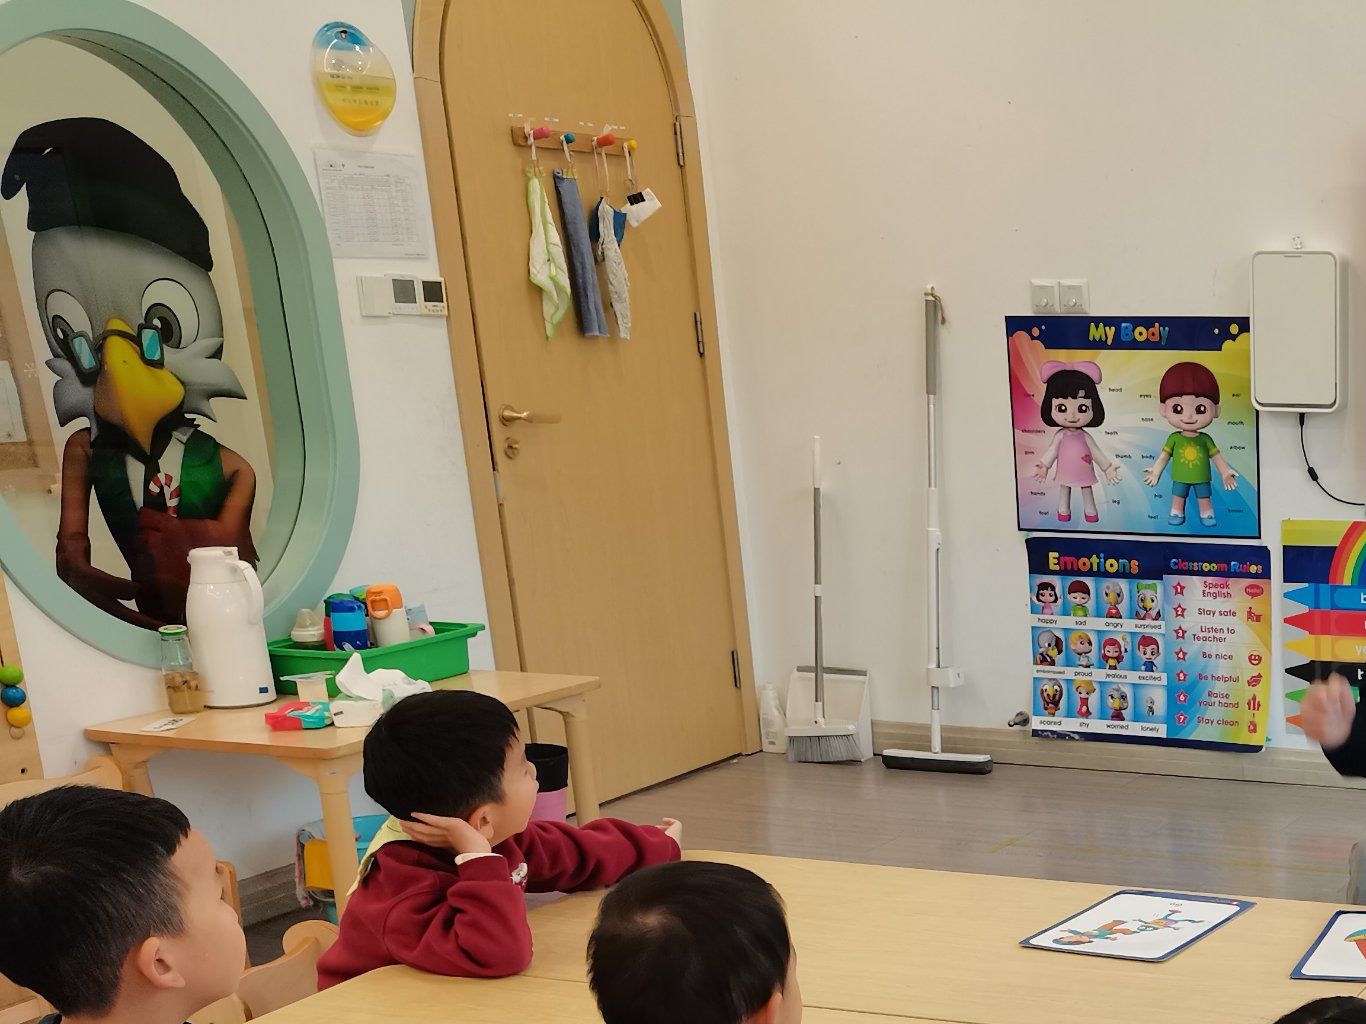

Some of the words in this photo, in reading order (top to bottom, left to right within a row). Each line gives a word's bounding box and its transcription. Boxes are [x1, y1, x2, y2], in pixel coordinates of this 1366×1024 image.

[1088, 322, 1115, 345] My
[1121, 322, 1169, 345] Body
[1048, 552, 1139, 575] Emotions
[1170, 558, 1229, 573] Classroom
[1230, 561, 1263, 574] Rules
[1203, 580, 1231, 590] Speak
[1202, 590, 1232, 599] English
[1197, 608, 1217, 617] Stay
[1218, 609, 1237, 617] safe
[1037, 617, 1058, 625] happy
[1104, 621, 1124, 629] angry
[1200, 626, 1225, 635] Listen
[1226, 627, 1236, 635] to
[1192, 634, 1227, 643] Teacher
[1202, 651, 1214, 659] Be
[1216, 652, 1234, 660] nice
[1105, 672, 1128, 680] jealous
[1198, 673, 1210, 681] Be
[1211, 673, 1240, 683] helpful
[1207, 691, 1231, 699] Raise
[1199, 700, 1219, 708] your
[1219, 700, 1240, 709] hand
[1197, 716, 1214, 725] Stay
[1216, 717, 1240, 727] clean
[1039, 719, 1062, 727] scared
[1079, 721, 1090, 729] shy
[1106, 724, 1130, 732] worried
[1141, 725, 1160, 734] lonely
